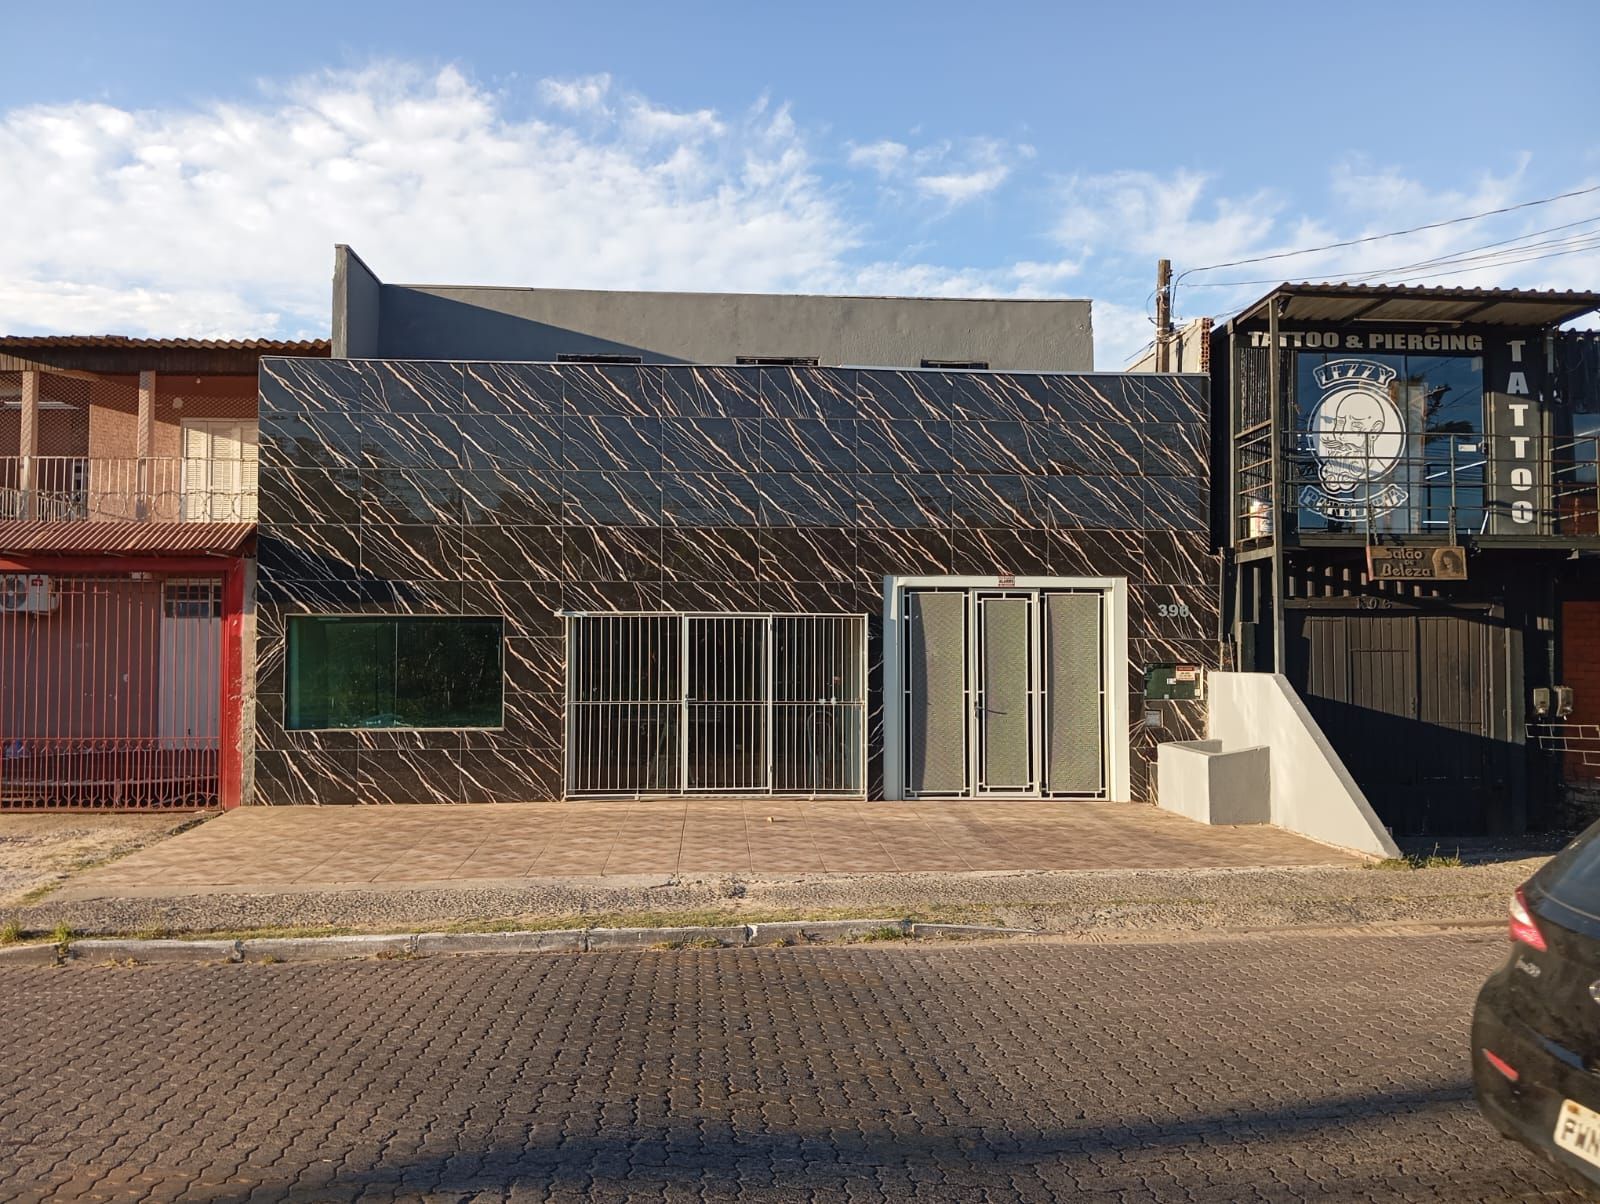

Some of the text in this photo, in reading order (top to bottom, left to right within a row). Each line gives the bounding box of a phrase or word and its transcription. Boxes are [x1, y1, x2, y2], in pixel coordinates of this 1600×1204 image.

[1248, 331, 1483, 351] TATTOO & PIERCING
[1506, 340, 1534, 524] TATTOO
[1380, 563, 1431, 577] Beleza
